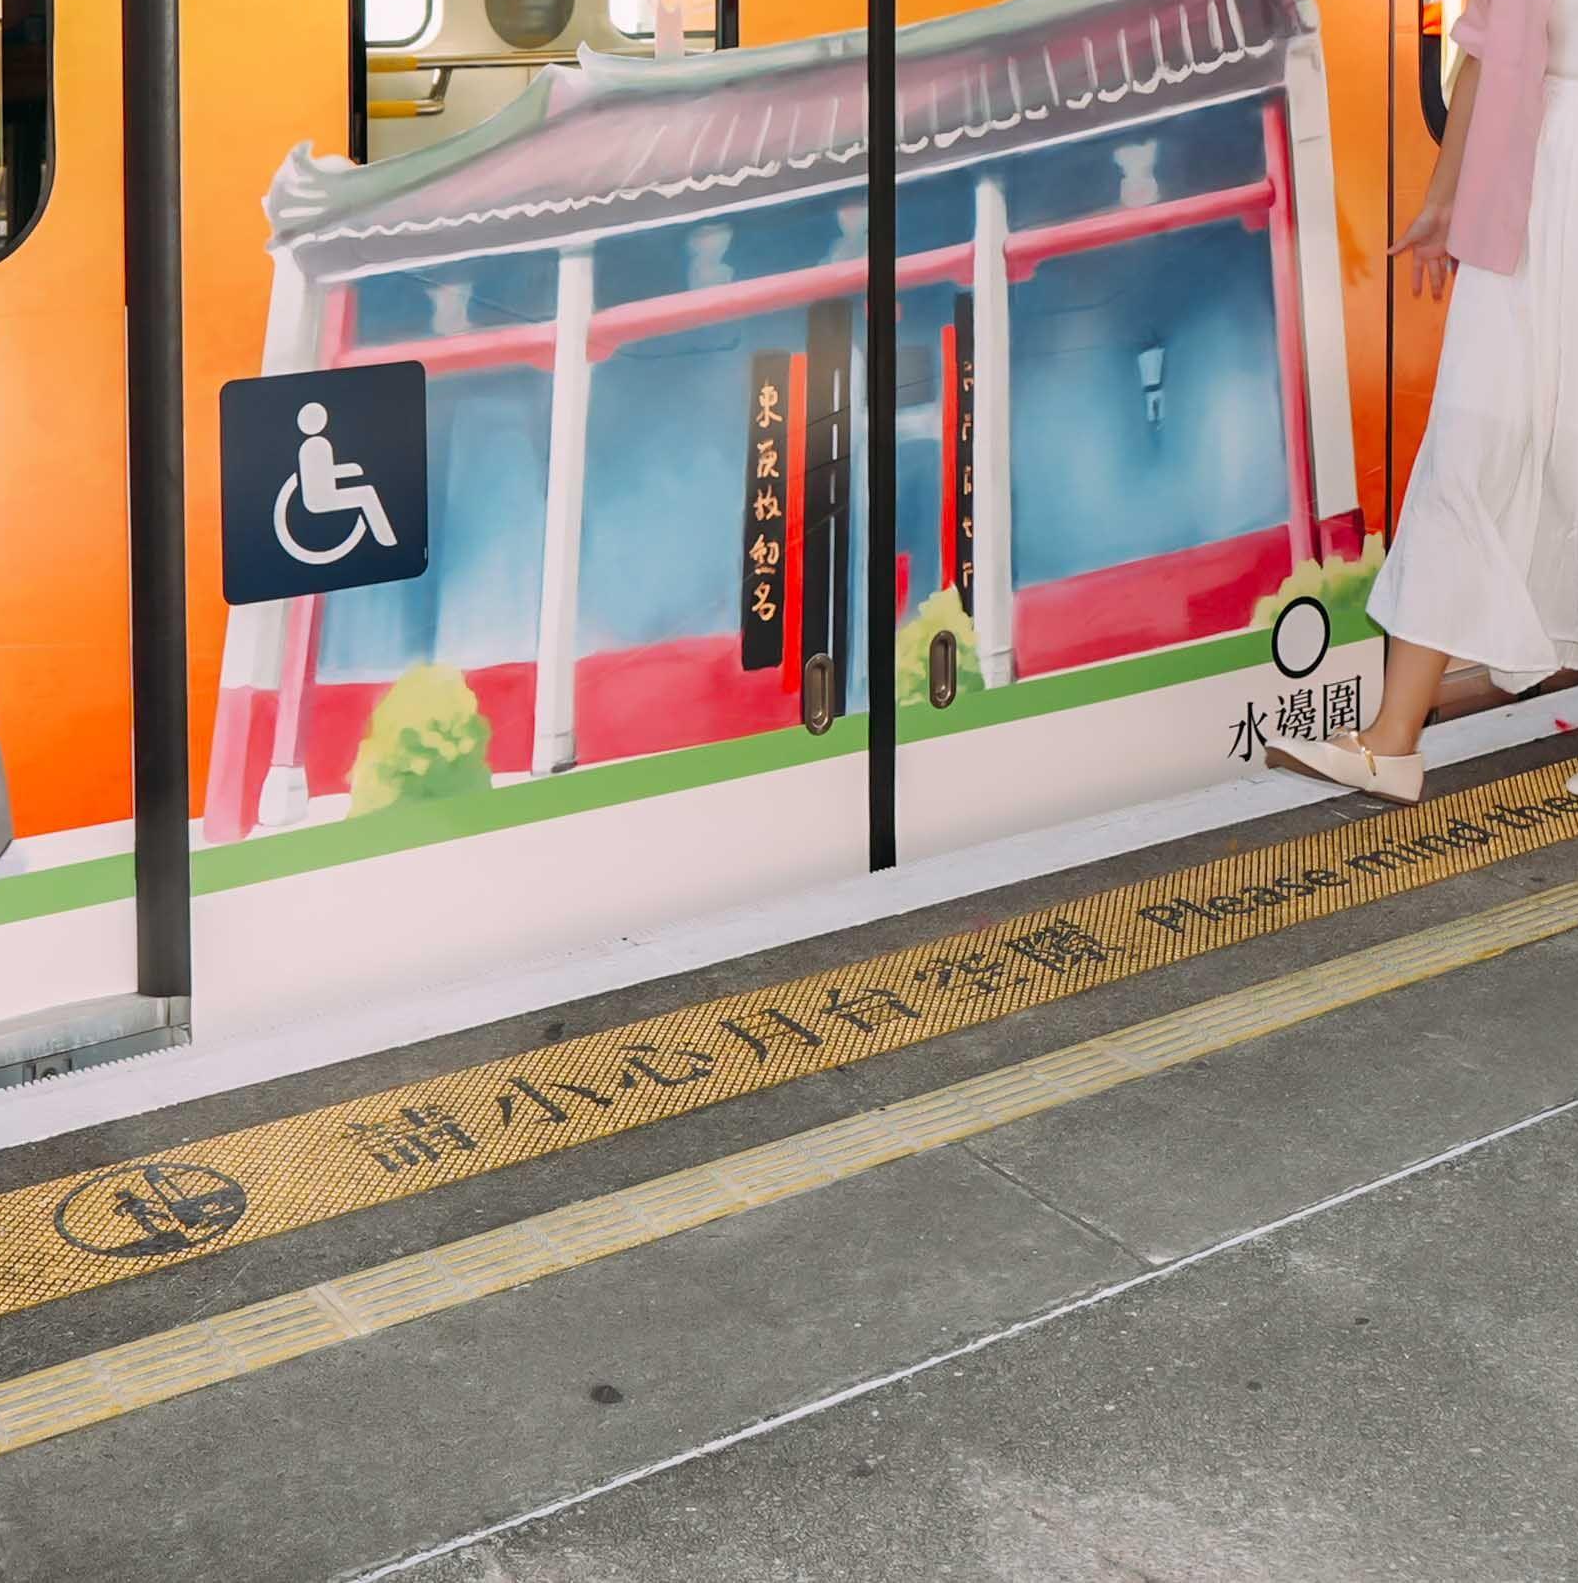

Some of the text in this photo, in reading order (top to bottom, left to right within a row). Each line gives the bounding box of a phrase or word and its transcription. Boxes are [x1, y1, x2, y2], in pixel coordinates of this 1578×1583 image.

[1227, 674, 1362, 762] 水邊圍
[1138, 866, 1349, 933] Please
[1343, 818, 1500, 876] mind
[345, 916, 1123, 1175] 請小心月台空隙
